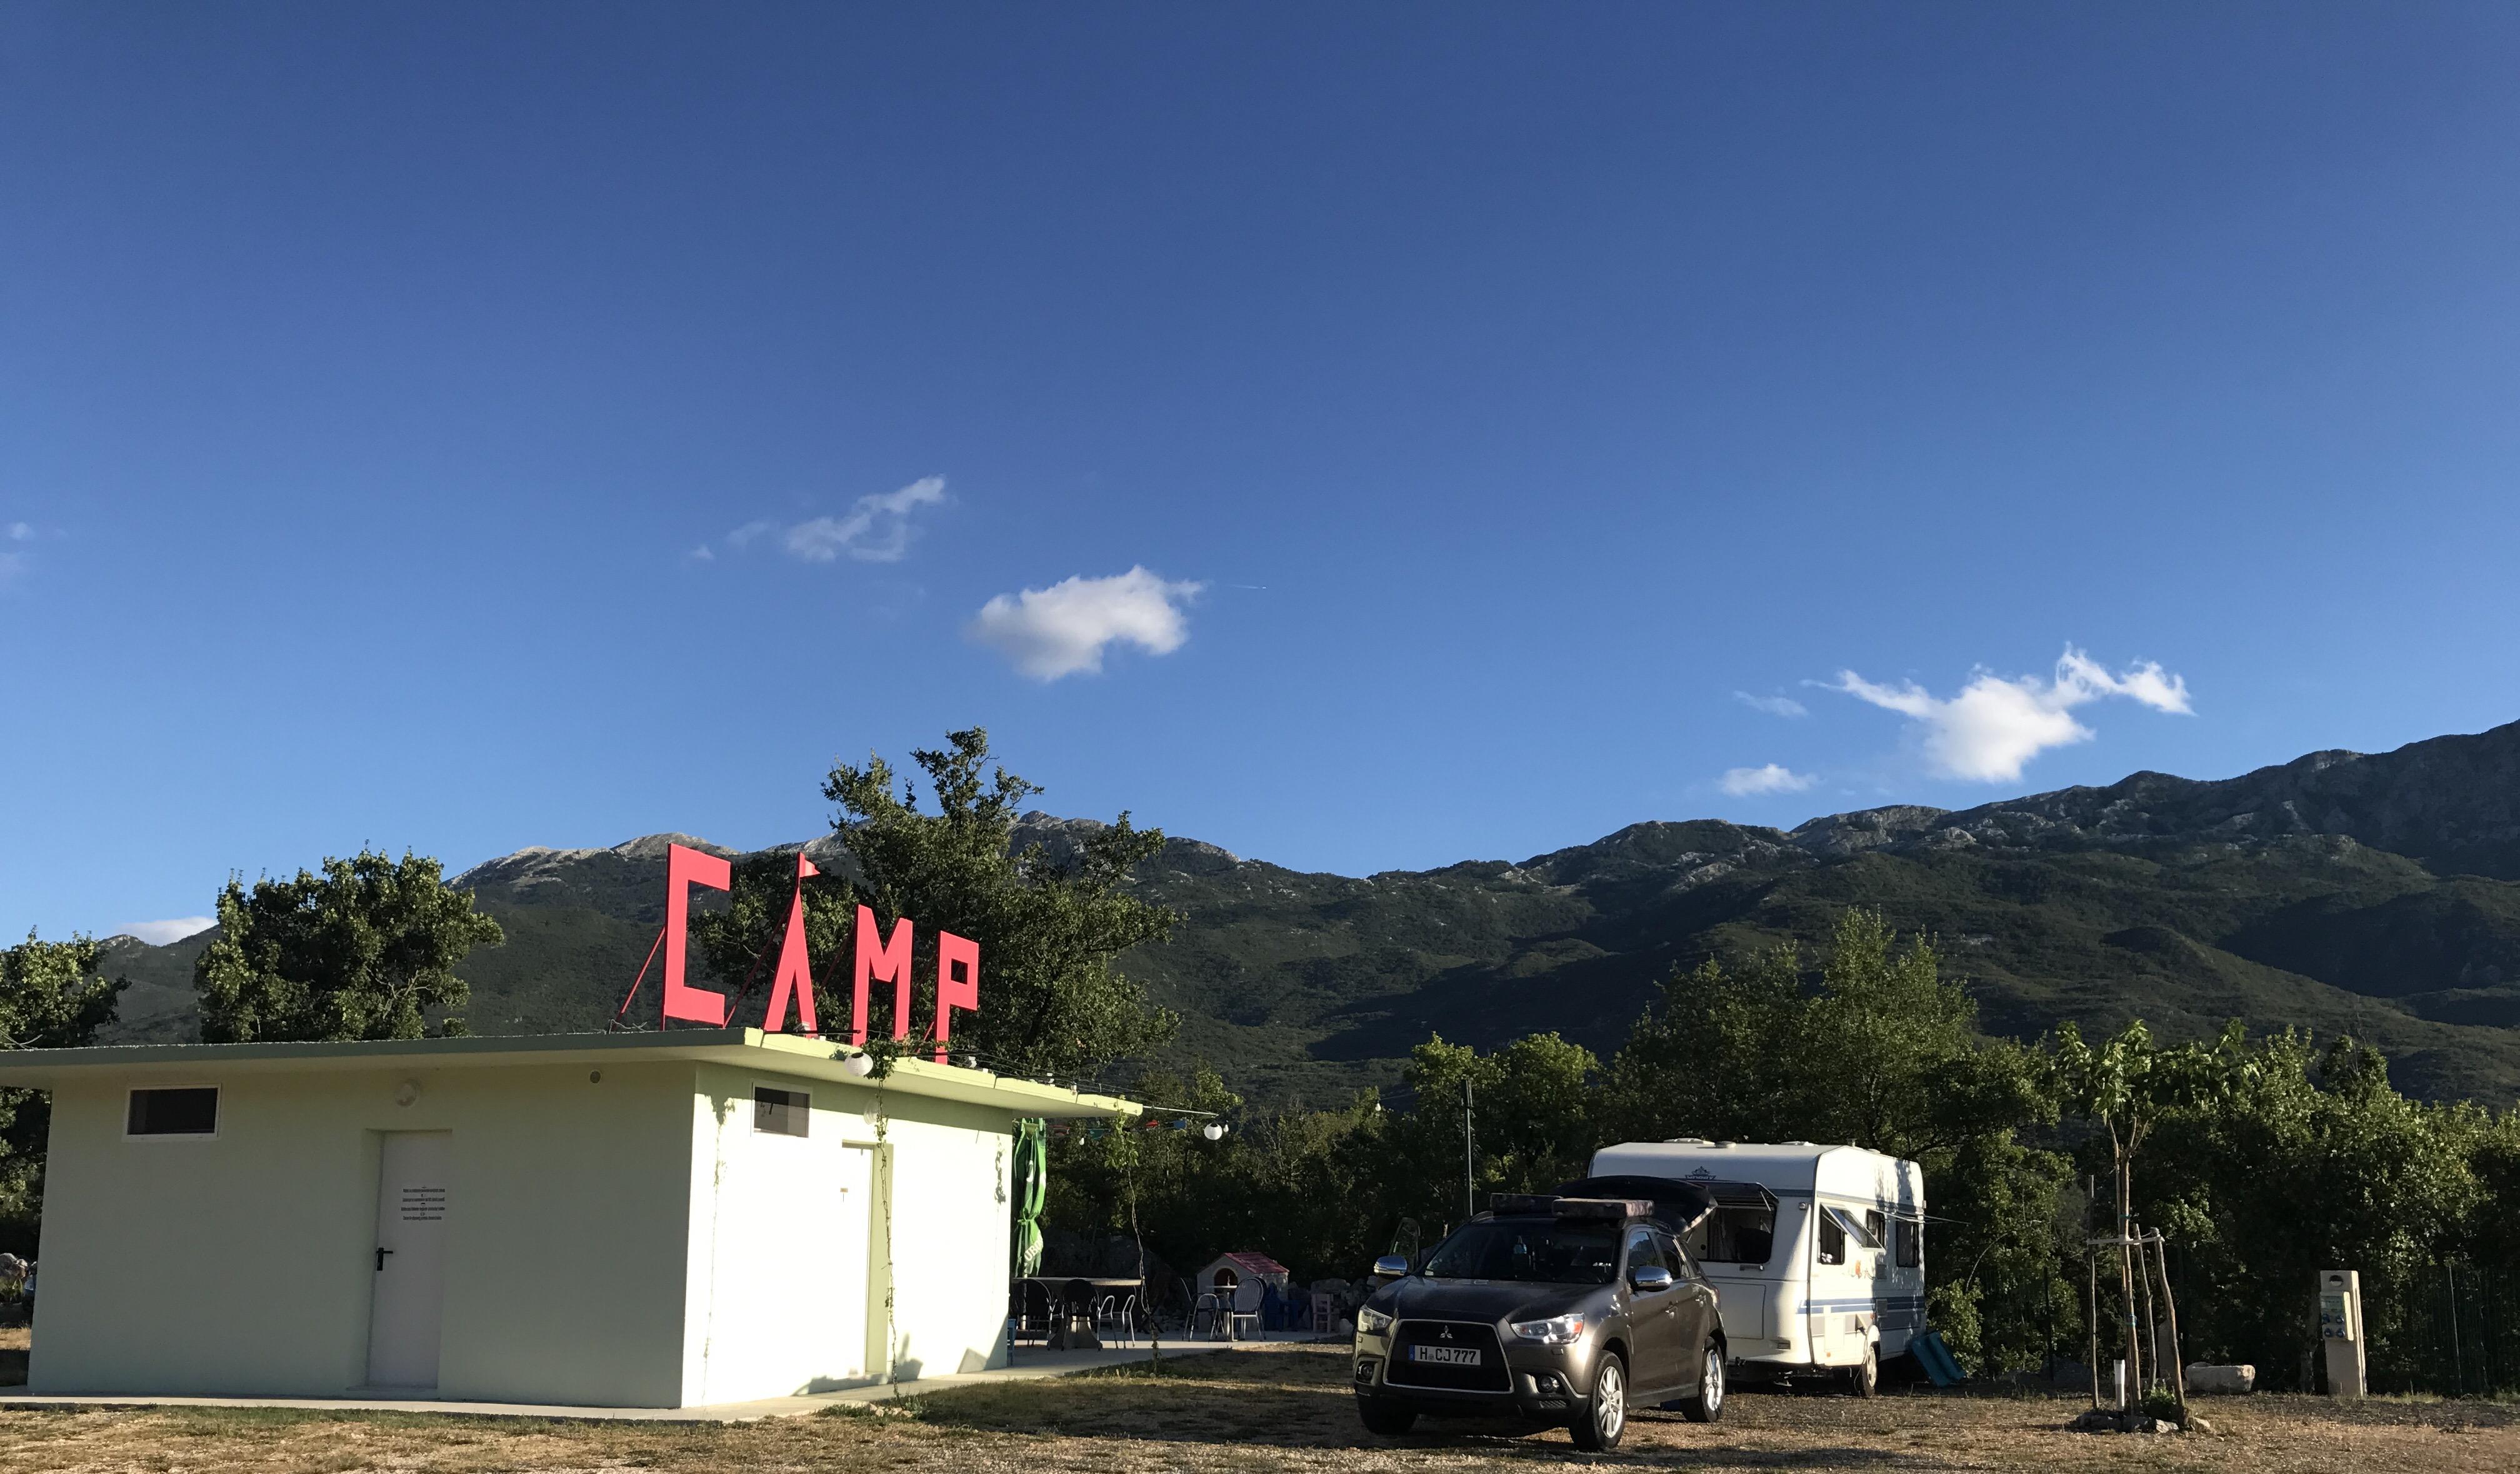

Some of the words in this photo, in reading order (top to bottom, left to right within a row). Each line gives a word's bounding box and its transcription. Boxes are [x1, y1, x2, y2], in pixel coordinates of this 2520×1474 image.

[662, 842, 979, 1065] CAMP
[1024, 1230, 1043, 1262] UBO
[1419, 1347, 1428, 1360] H
[1435, 1348, 1451, 1362] CJ
[1453, 1349, 1477, 1363] 777
